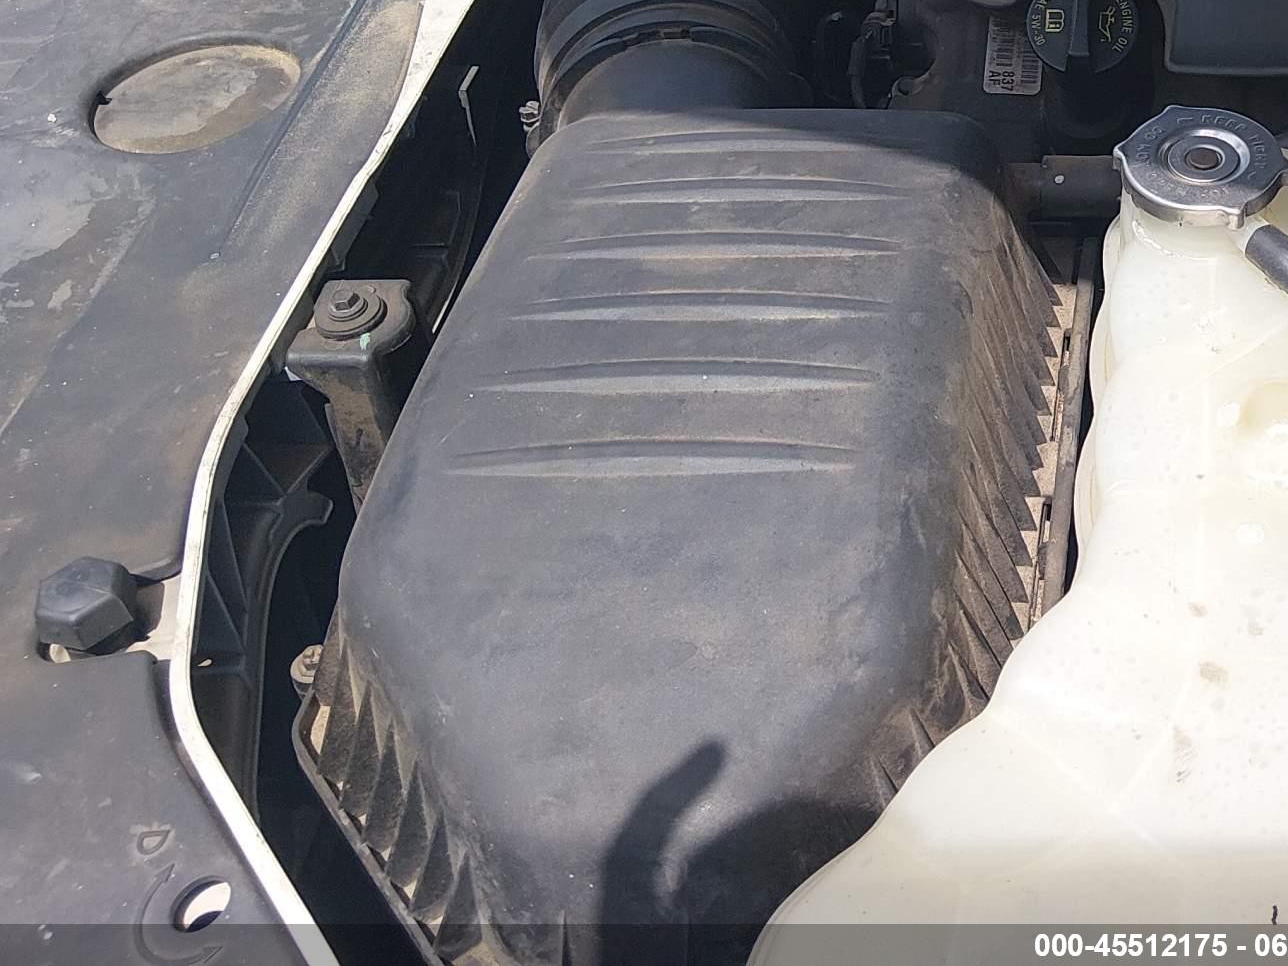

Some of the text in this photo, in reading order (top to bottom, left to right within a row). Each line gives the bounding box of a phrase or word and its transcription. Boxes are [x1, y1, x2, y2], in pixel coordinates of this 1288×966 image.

[1031, 13, 1046, 46] 5W-30
[1112, 37, 1128, 53] OIL
[989, 69, 1002, 86] AF
[1001, 70, 1016, 91] 837
